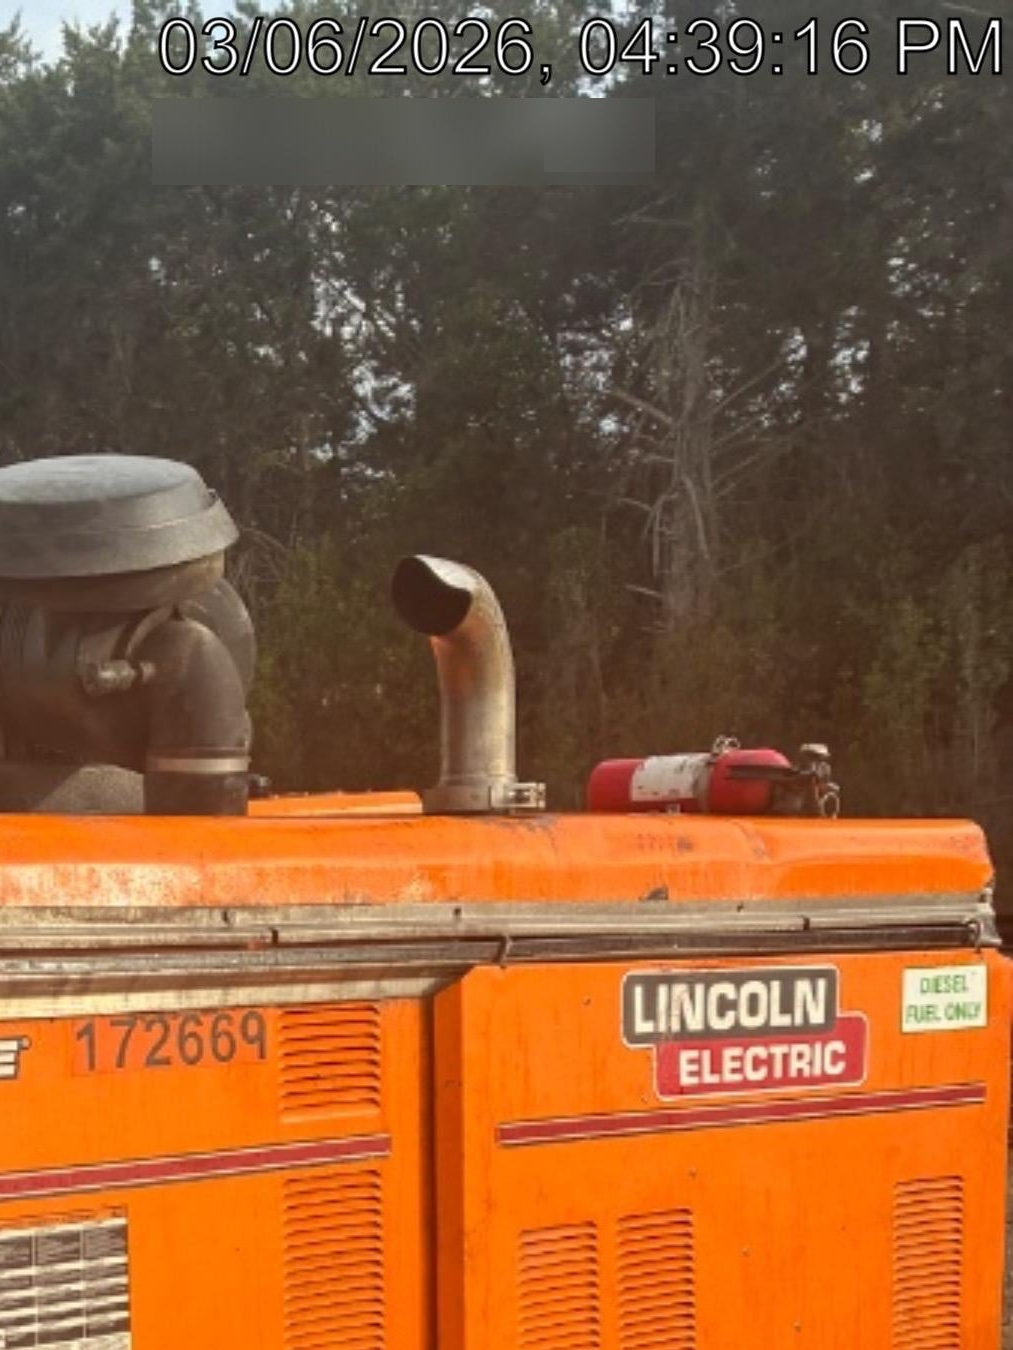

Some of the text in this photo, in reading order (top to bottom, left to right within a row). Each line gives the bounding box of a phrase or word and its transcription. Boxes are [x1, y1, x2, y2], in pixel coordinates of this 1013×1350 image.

[633, 977, 828, 1034] LINCOLN
[920, 973, 968, 995] DIESEL
[905, 1002, 983, 1025] FUEL ONLY
[74, 1011, 269, 1071] 172669
[678, 1040, 847, 1086] ELECTRIC
